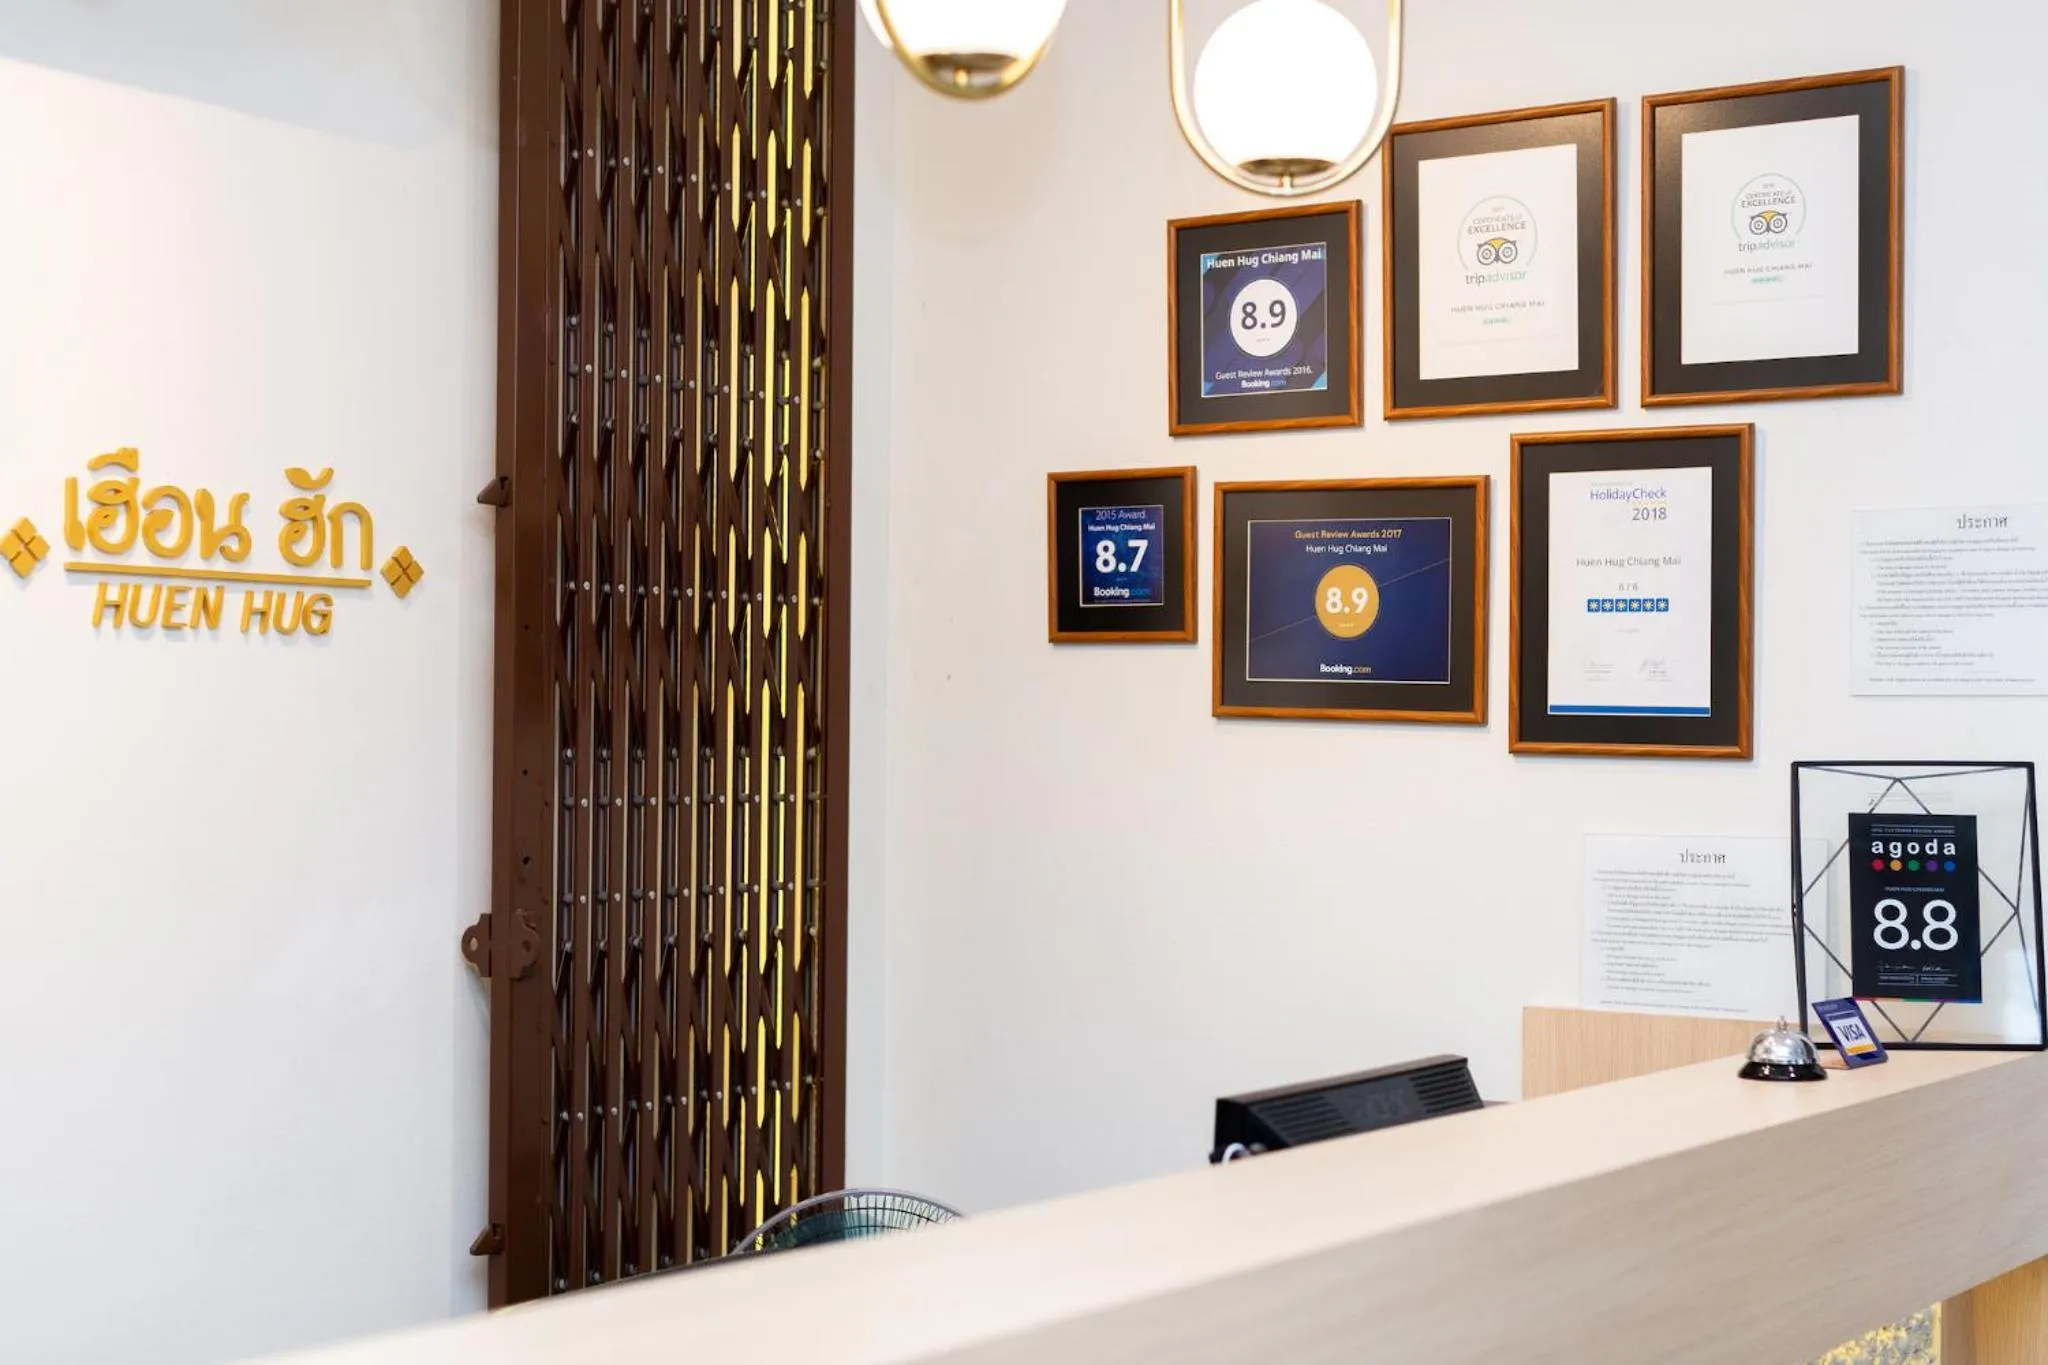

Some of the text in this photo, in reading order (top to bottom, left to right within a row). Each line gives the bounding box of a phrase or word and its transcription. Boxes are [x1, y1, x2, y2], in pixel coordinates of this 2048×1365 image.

[1741, 195, 1796, 208] EXCELLENCE
[1467, 220, 1527, 235] EXCELLENCE
[1738, 238, 1796, 254] tripadvisor
[1207, 248, 1321, 269] Huen Hug Chiang Mai
[1465, 270, 1528, 287] tripadvisor
[1241, 299, 1286, 330] 8.9
[1589, 487, 1667, 503] HolidayCheck
[64, 447, 374, 571] เฮือน ฮัก
[1095, 509, 1146, 520] 2015 Award
[1632, 506, 1668, 521] 2018
[1956, 513, 2008, 529] ประกาศ
[1294, 528, 1403, 539] Guest Review Awards 2017
[1095, 539, 1149, 573] 8.7
[1306, 544, 1388, 554] Huen Hug Chiang Mai
[1576, 556, 1681, 568] Huen Hug Chiang Mai
[92, 581, 335, 636] HUEN HUG
[1325, 587, 1369, 614] 8.9
[1320, 663, 1372, 675] Booking.com
[1679, 847, 1726, 864] ประกาศ
[1871, 838, 1956, 858] agoda
[1873, 898, 1959, 951] 8.8
[1836, 1023, 1866, 1042] VISA
